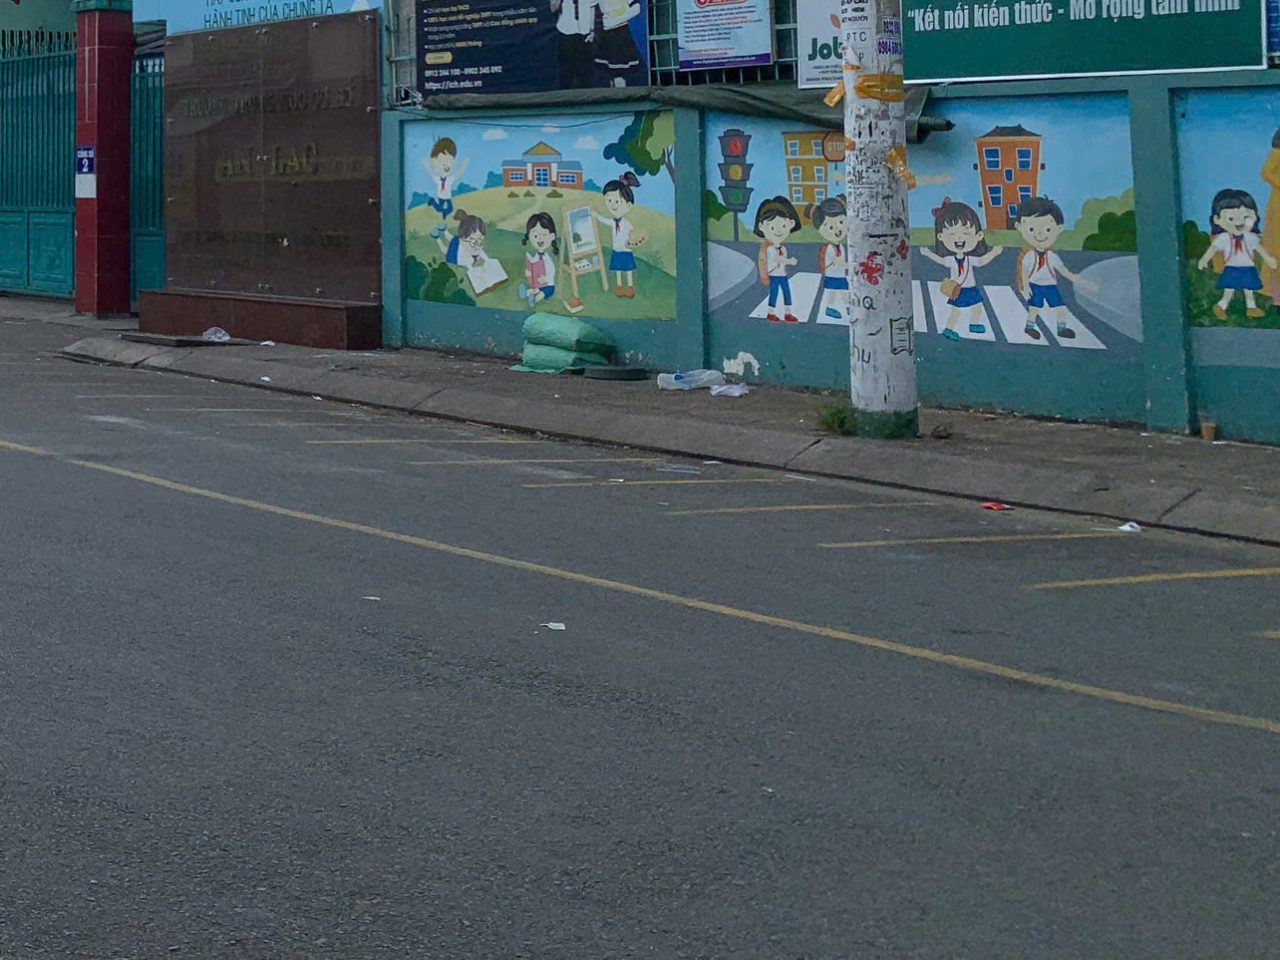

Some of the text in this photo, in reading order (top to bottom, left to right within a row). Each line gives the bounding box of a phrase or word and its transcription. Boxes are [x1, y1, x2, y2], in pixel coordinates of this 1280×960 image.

[204, 9, 233, 29] HÀNH
[235, 7, 256, 26] TINH
[258, 0, 279, 23] CỦA
[944, 2, 969, 29] nối
[974, 0, 1009, 28] kiến
[1014, 0, 1052, 24] thức
[82, 158, 89, 172] 2
